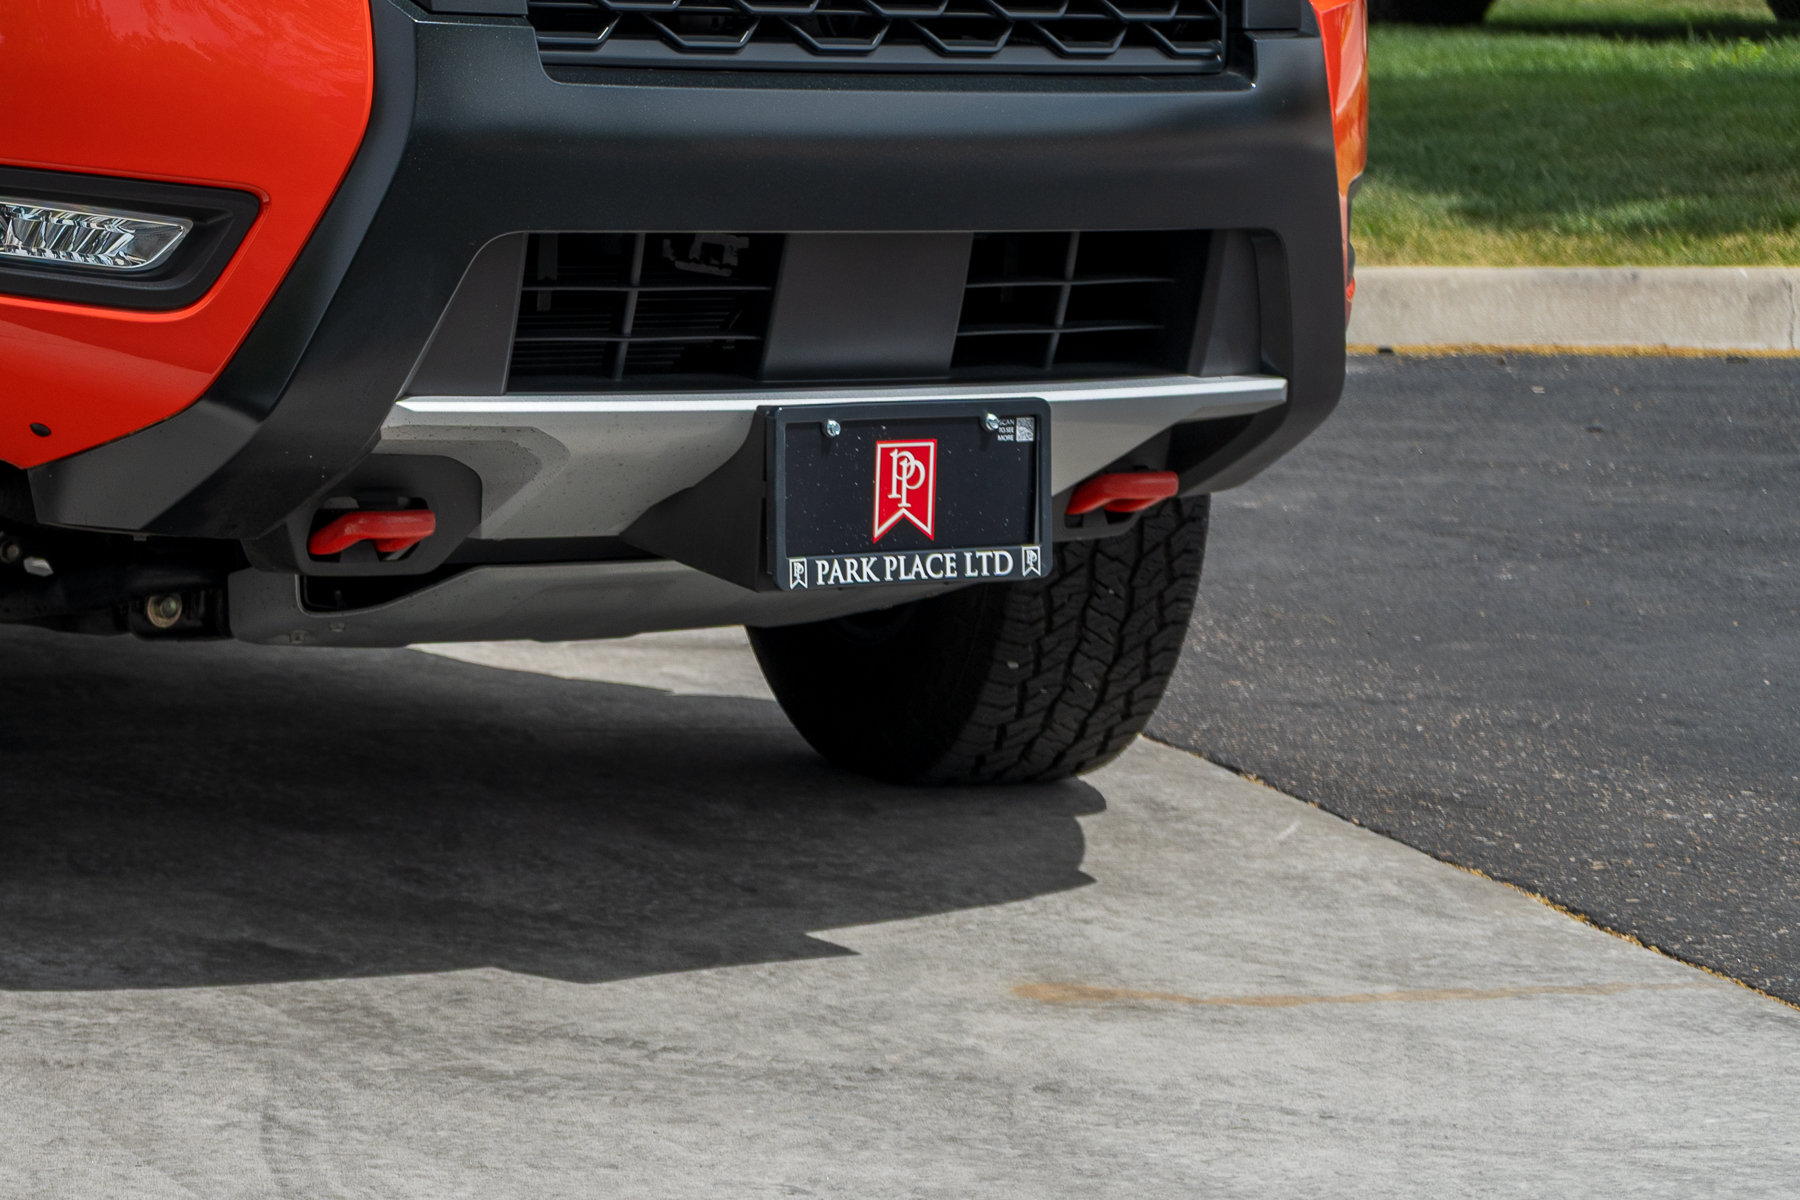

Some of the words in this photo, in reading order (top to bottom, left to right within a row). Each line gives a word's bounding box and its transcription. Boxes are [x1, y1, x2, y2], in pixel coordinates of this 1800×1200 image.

[816, 557, 881, 586] PARK
[884, 552, 958, 582] PLACE
[964, 549, 1014, 578] LTD
